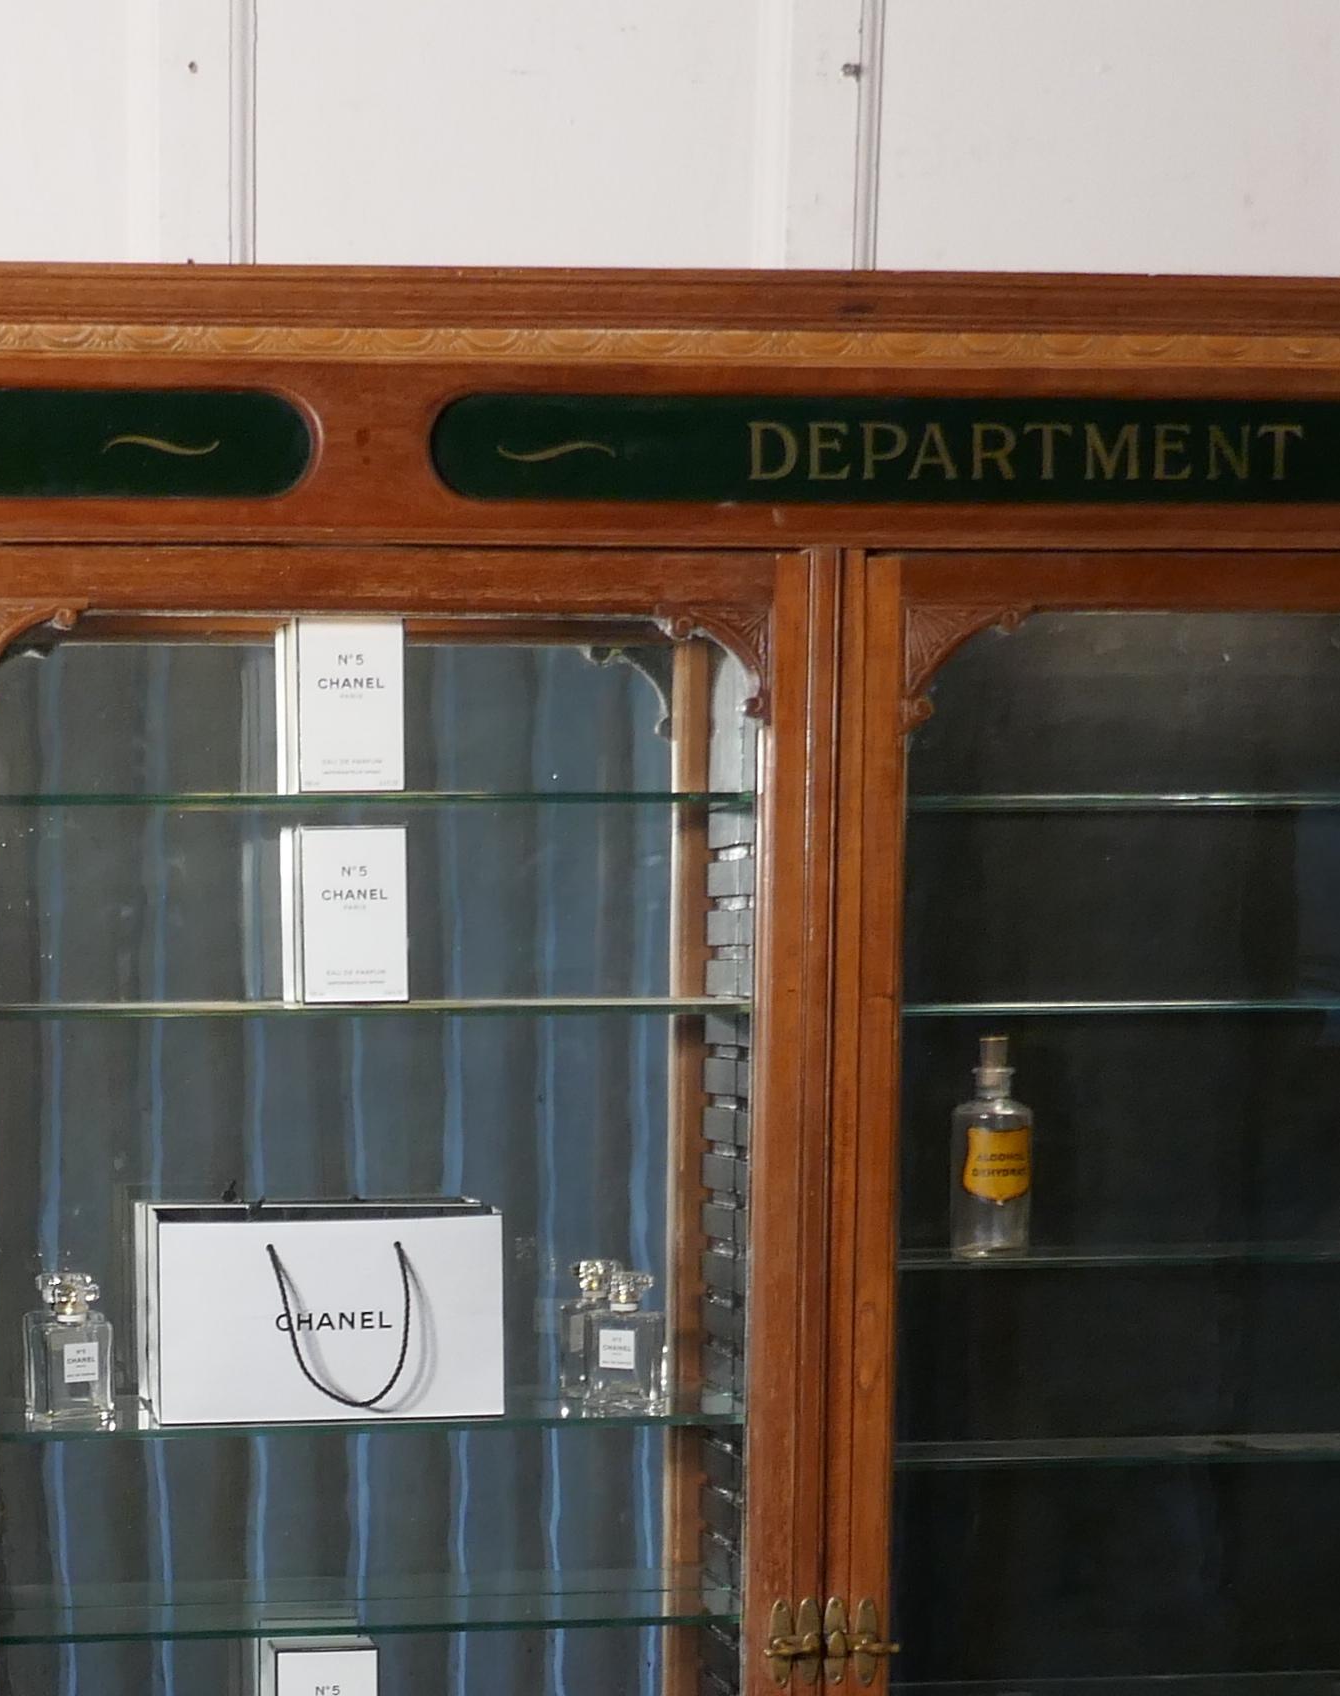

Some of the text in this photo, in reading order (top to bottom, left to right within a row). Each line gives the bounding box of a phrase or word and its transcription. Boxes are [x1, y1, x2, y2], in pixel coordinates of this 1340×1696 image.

[746, 420, 1304, 482] DEPARTMENT
[317, 677, 386, 690] CHANEL
[320, 888, 389, 901] CHANEL
[275, 1310, 394, 1332] CHANEL
